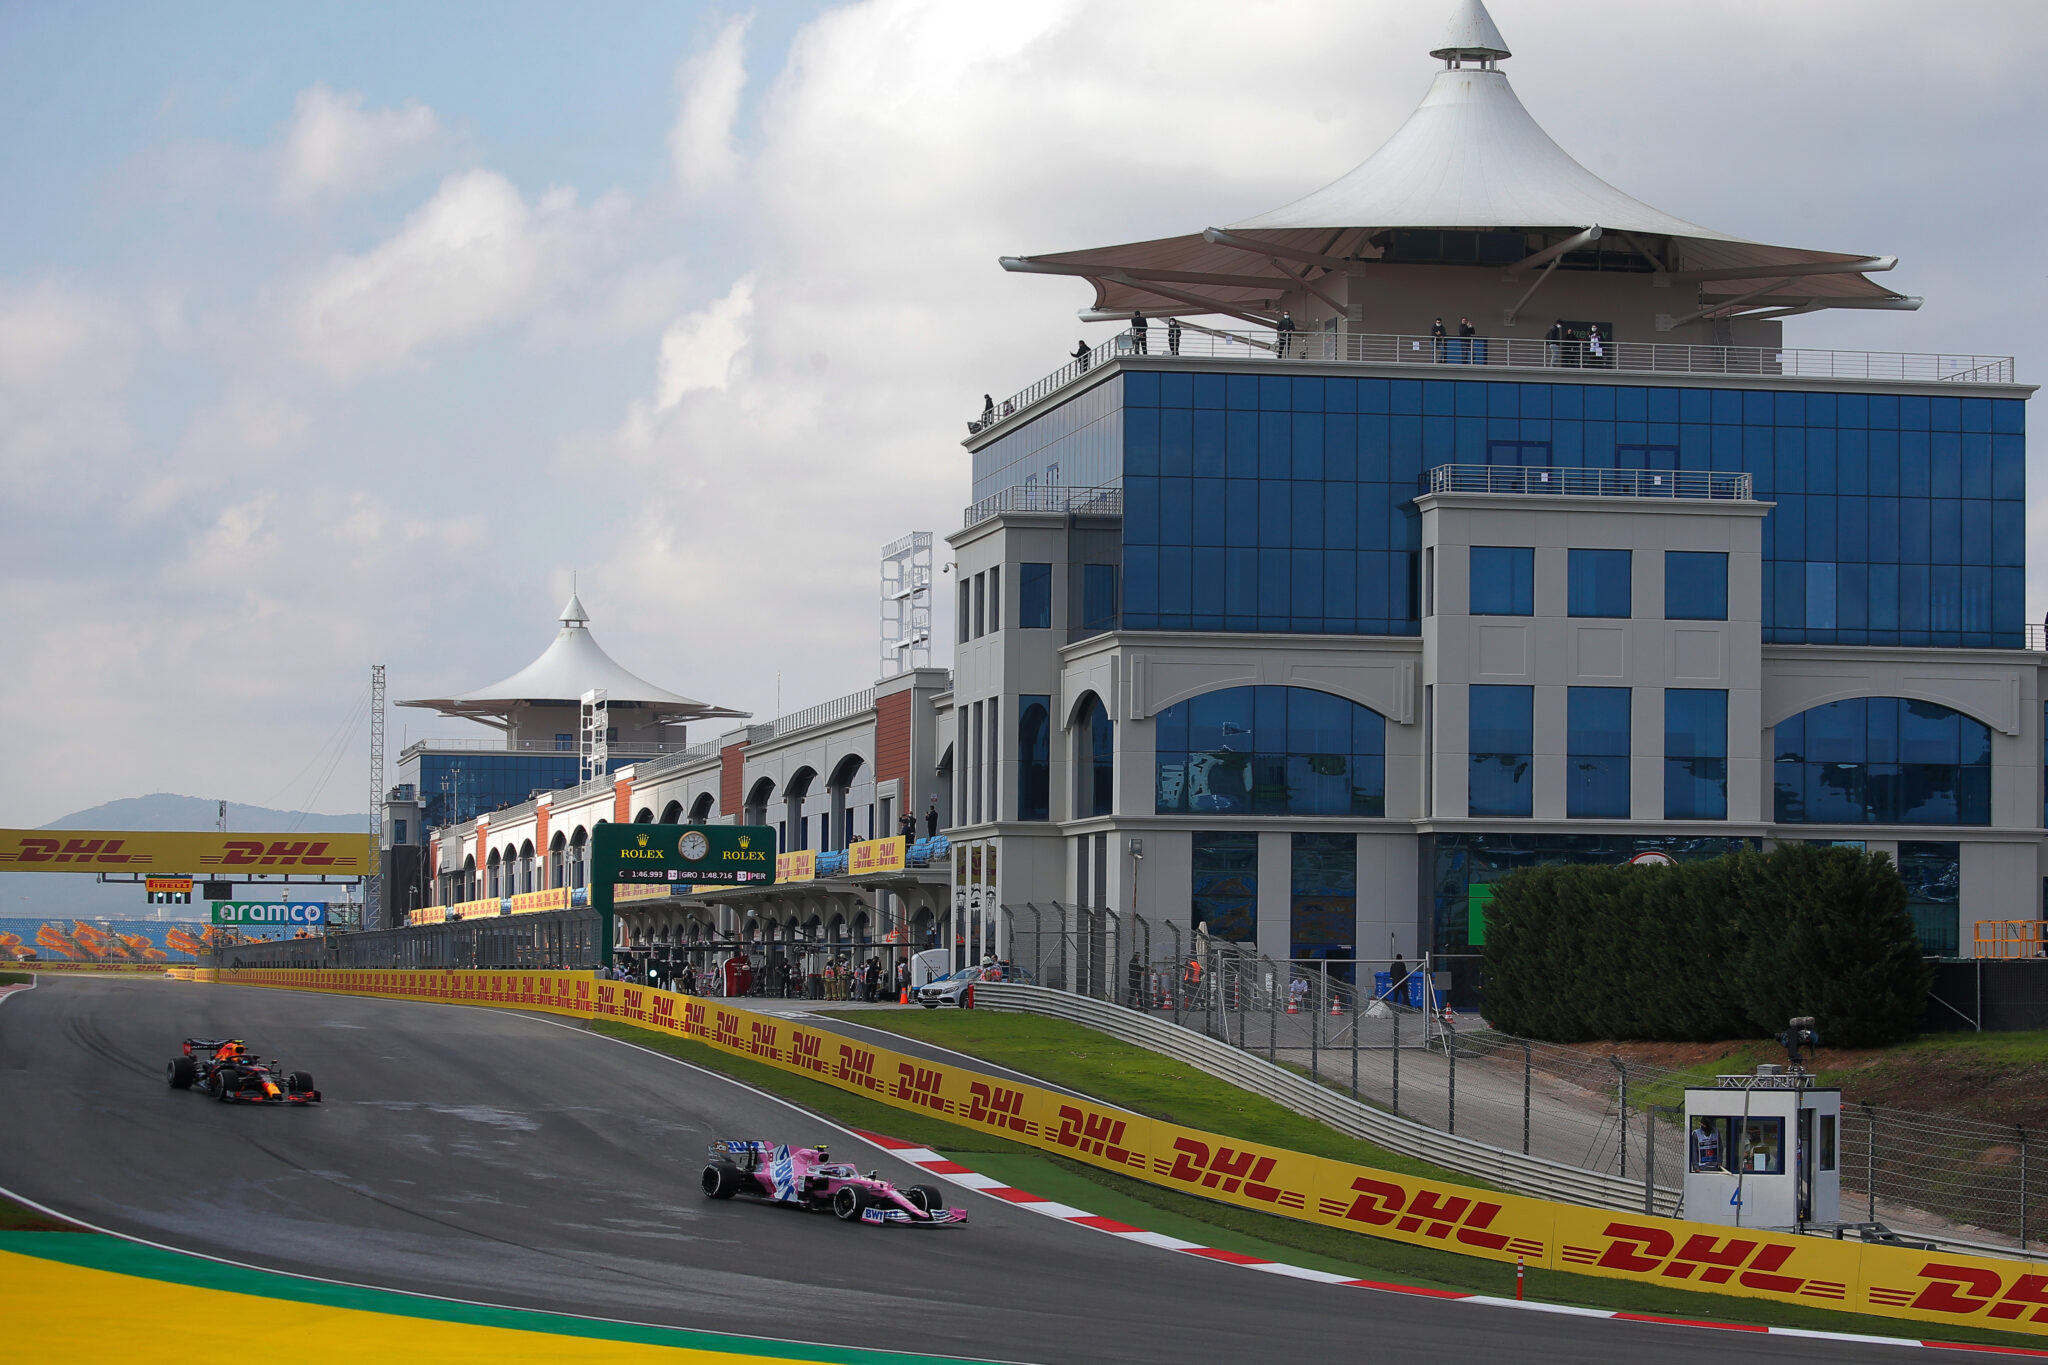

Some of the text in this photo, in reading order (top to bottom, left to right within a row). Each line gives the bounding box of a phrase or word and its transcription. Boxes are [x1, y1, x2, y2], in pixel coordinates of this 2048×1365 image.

[17, 838, 336, 865] DHL DHL
[620, 849, 664, 859] ROLEX
[722, 851, 766, 860] ROLEX
[681, 871, 698, 879] GRO
[148, 879, 191, 889] PIRELLI
[220, 904, 321, 921] aramco
[598, 985, 616, 1014] DHL
[623, 989, 643, 1020] DHL
[652, 995, 675, 1029] DHL
[684, 1003, 706, 1038] DHL
[716, 1011, 741, 1048] DHL
[751, 1022, 778, 1060] DHL
[792, 1031, 823, 1072] DHL
[838, 1044, 877, 1090] DHL
[897, 1062, 945, 1111] DHL
[968, 1081, 1027, 1134] DHL
[1057, 1105, 1130, 1164] DHL
[1170, 1136, 1284, 1203] DHL
[1345, 1176, 1511, 1250] DHL
[1596, 1222, 1806, 1294] DHL
[1729, 1186, 1743, 1206] 4
[865, 1208, 884, 1221] BWT
